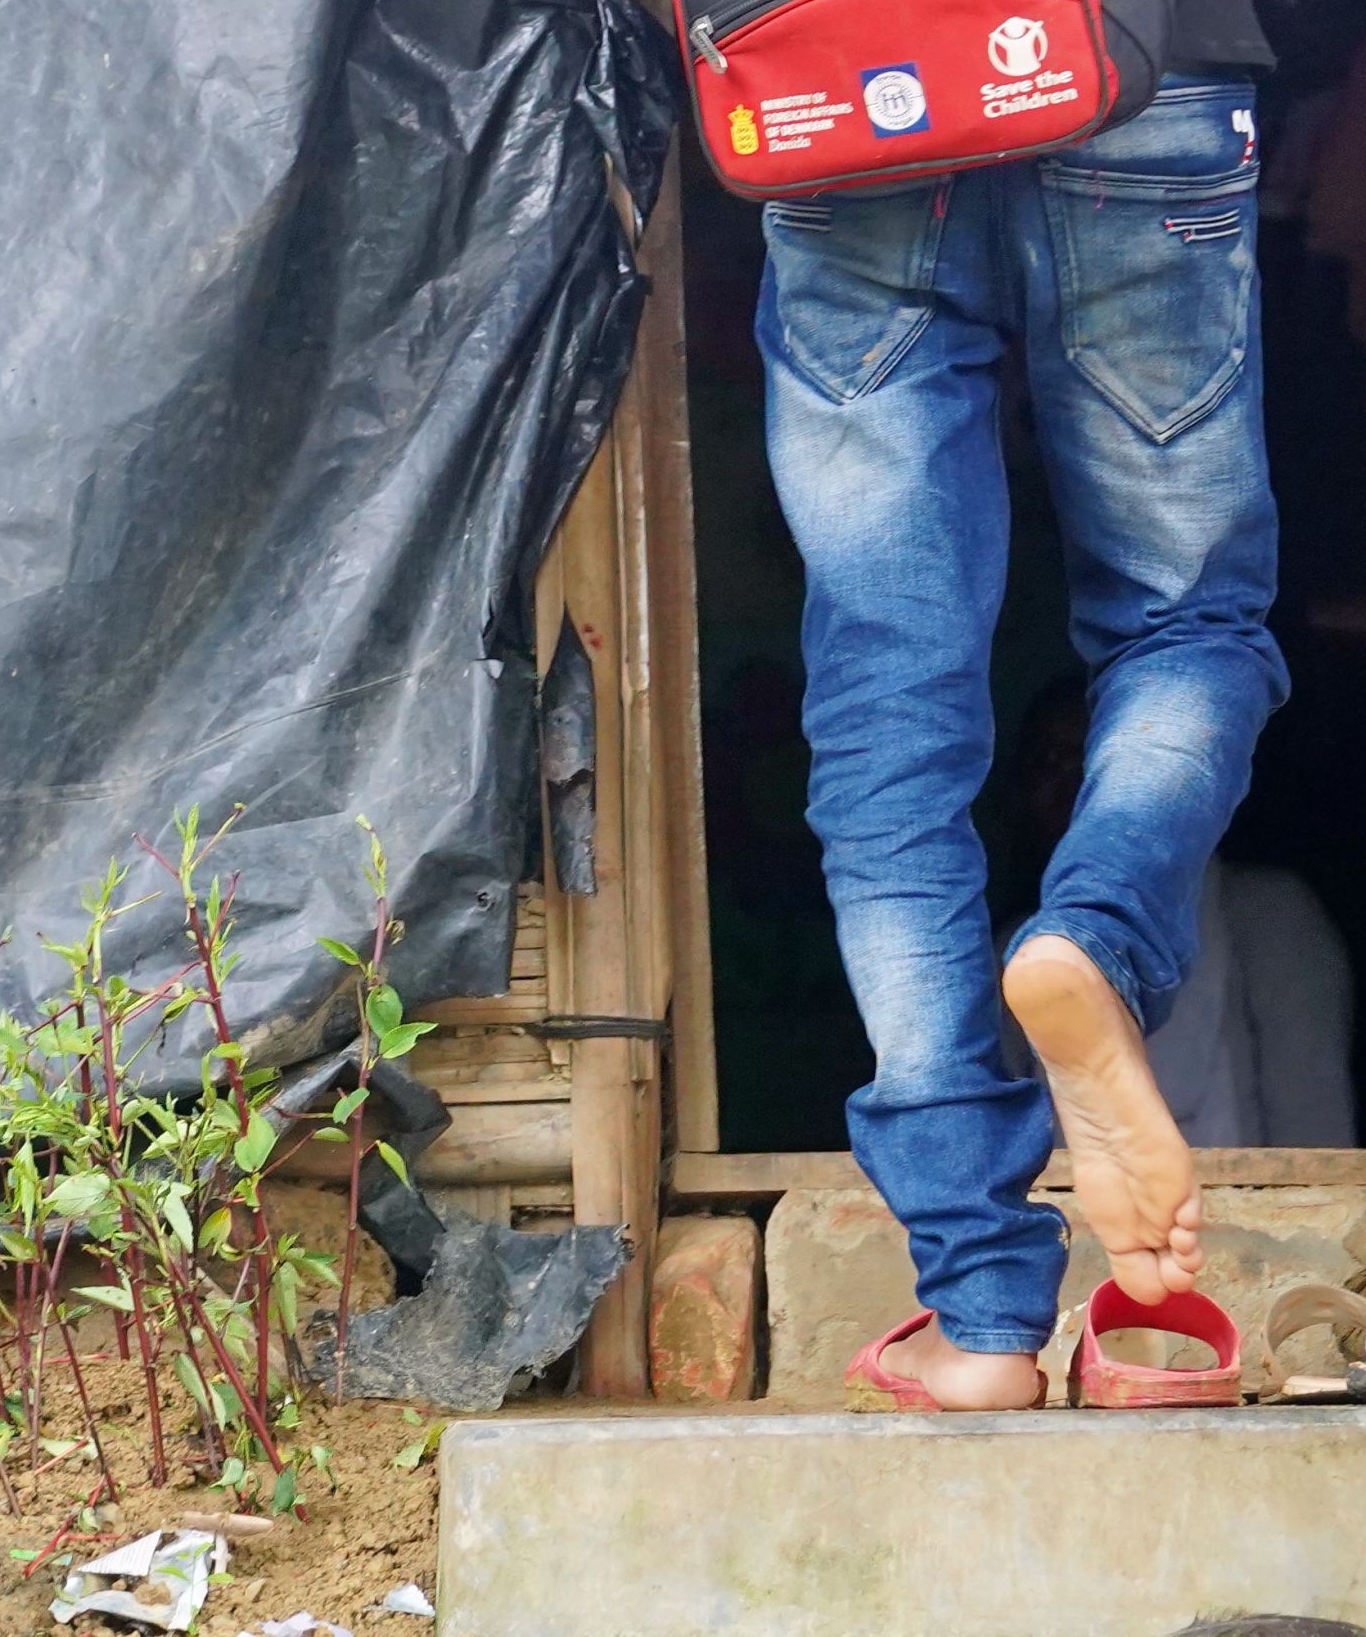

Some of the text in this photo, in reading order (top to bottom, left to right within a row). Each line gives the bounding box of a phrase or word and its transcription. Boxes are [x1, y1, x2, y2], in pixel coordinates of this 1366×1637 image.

[980, 70, 1074, 101] Save the
[983, 87, 1079, 118] Children
